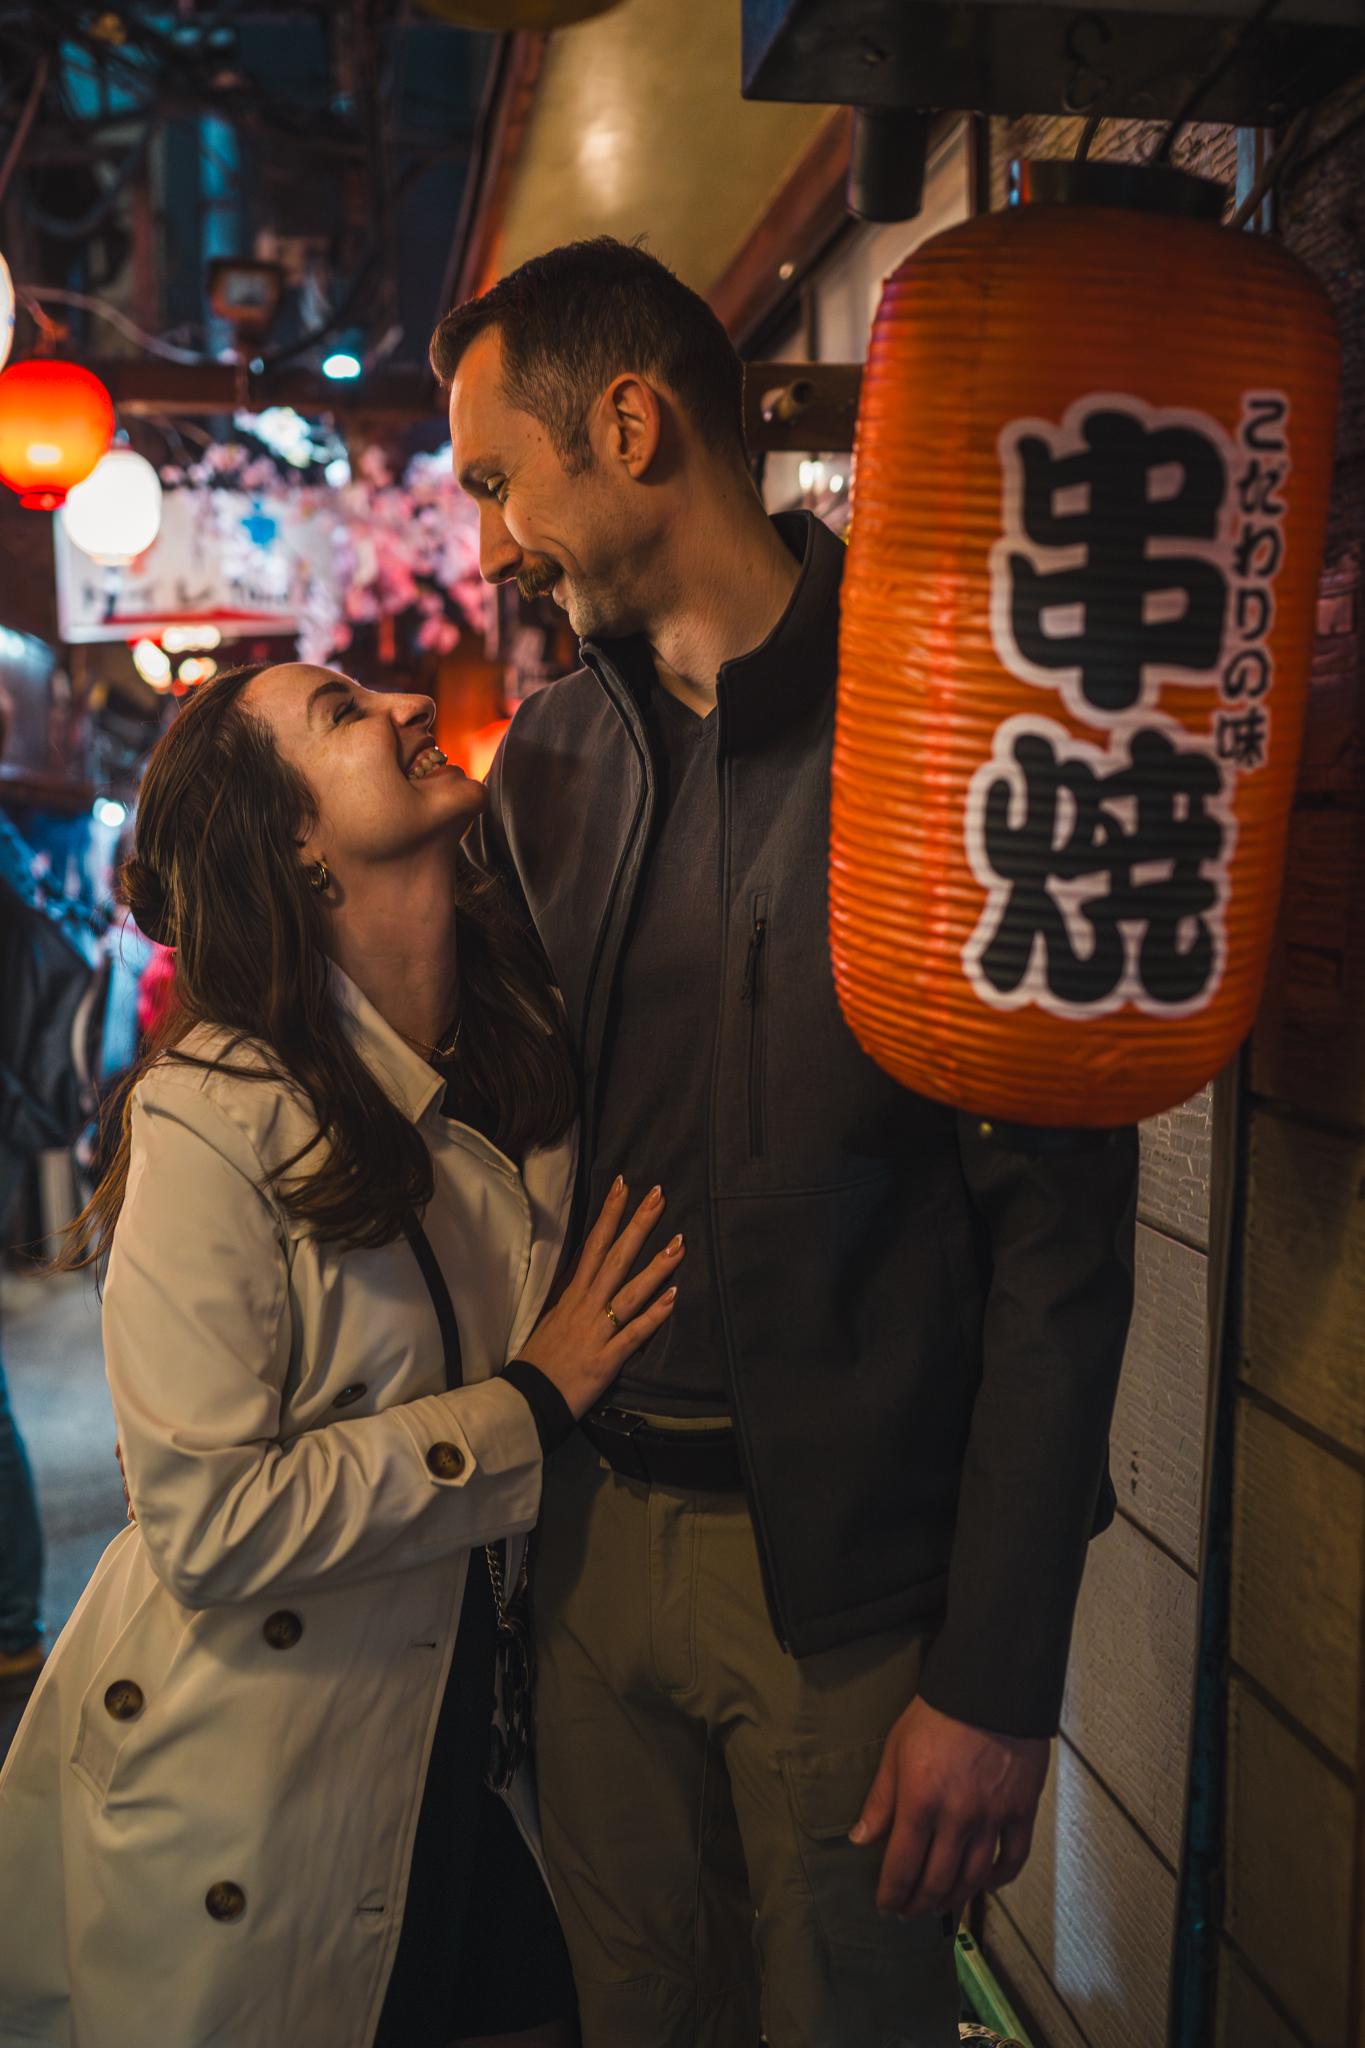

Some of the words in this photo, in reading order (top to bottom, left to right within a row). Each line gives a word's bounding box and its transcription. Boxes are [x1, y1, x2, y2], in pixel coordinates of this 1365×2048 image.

[978, 407, 1231, 1005] 串焼
[1216, 397, 1289, 767] こだわりの味
